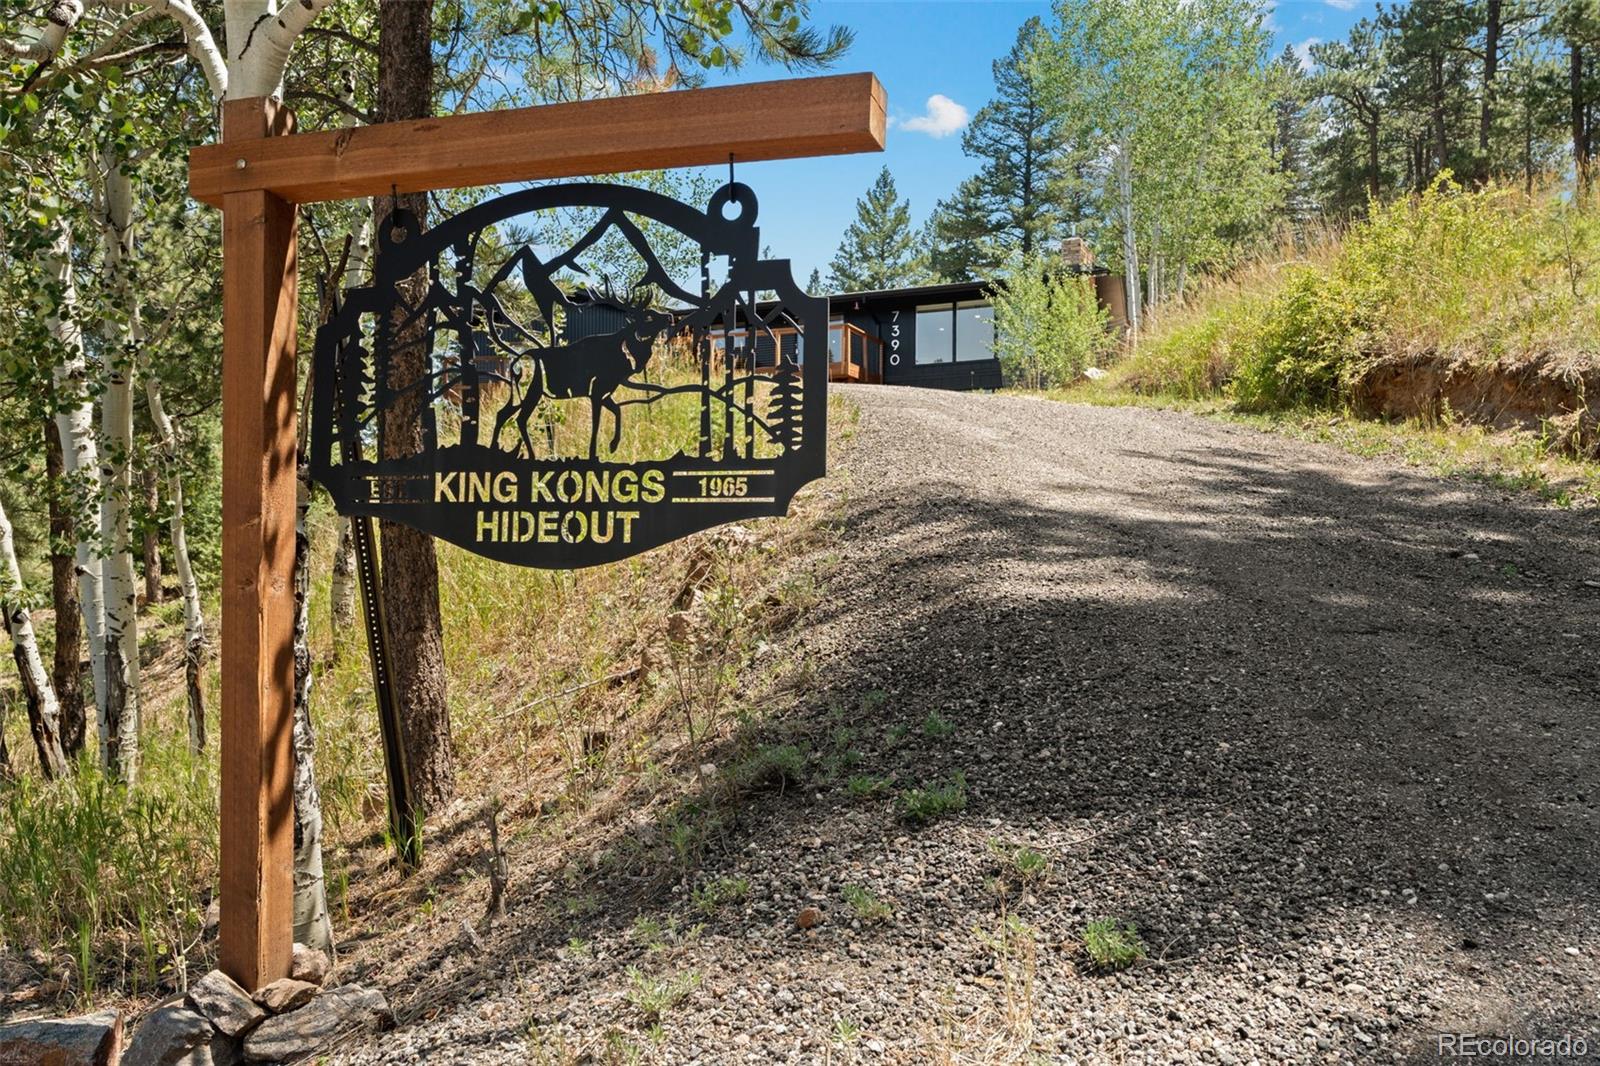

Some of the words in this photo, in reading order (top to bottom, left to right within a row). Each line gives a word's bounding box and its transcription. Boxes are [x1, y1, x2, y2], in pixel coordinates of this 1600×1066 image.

[890, 311, 900, 366] 7390
[434, 471, 519, 503] KING
[531, 469, 666, 503] KONGS
[699, 477, 748, 497] 1965
[476, 510, 640, 544] HIDEOUT
